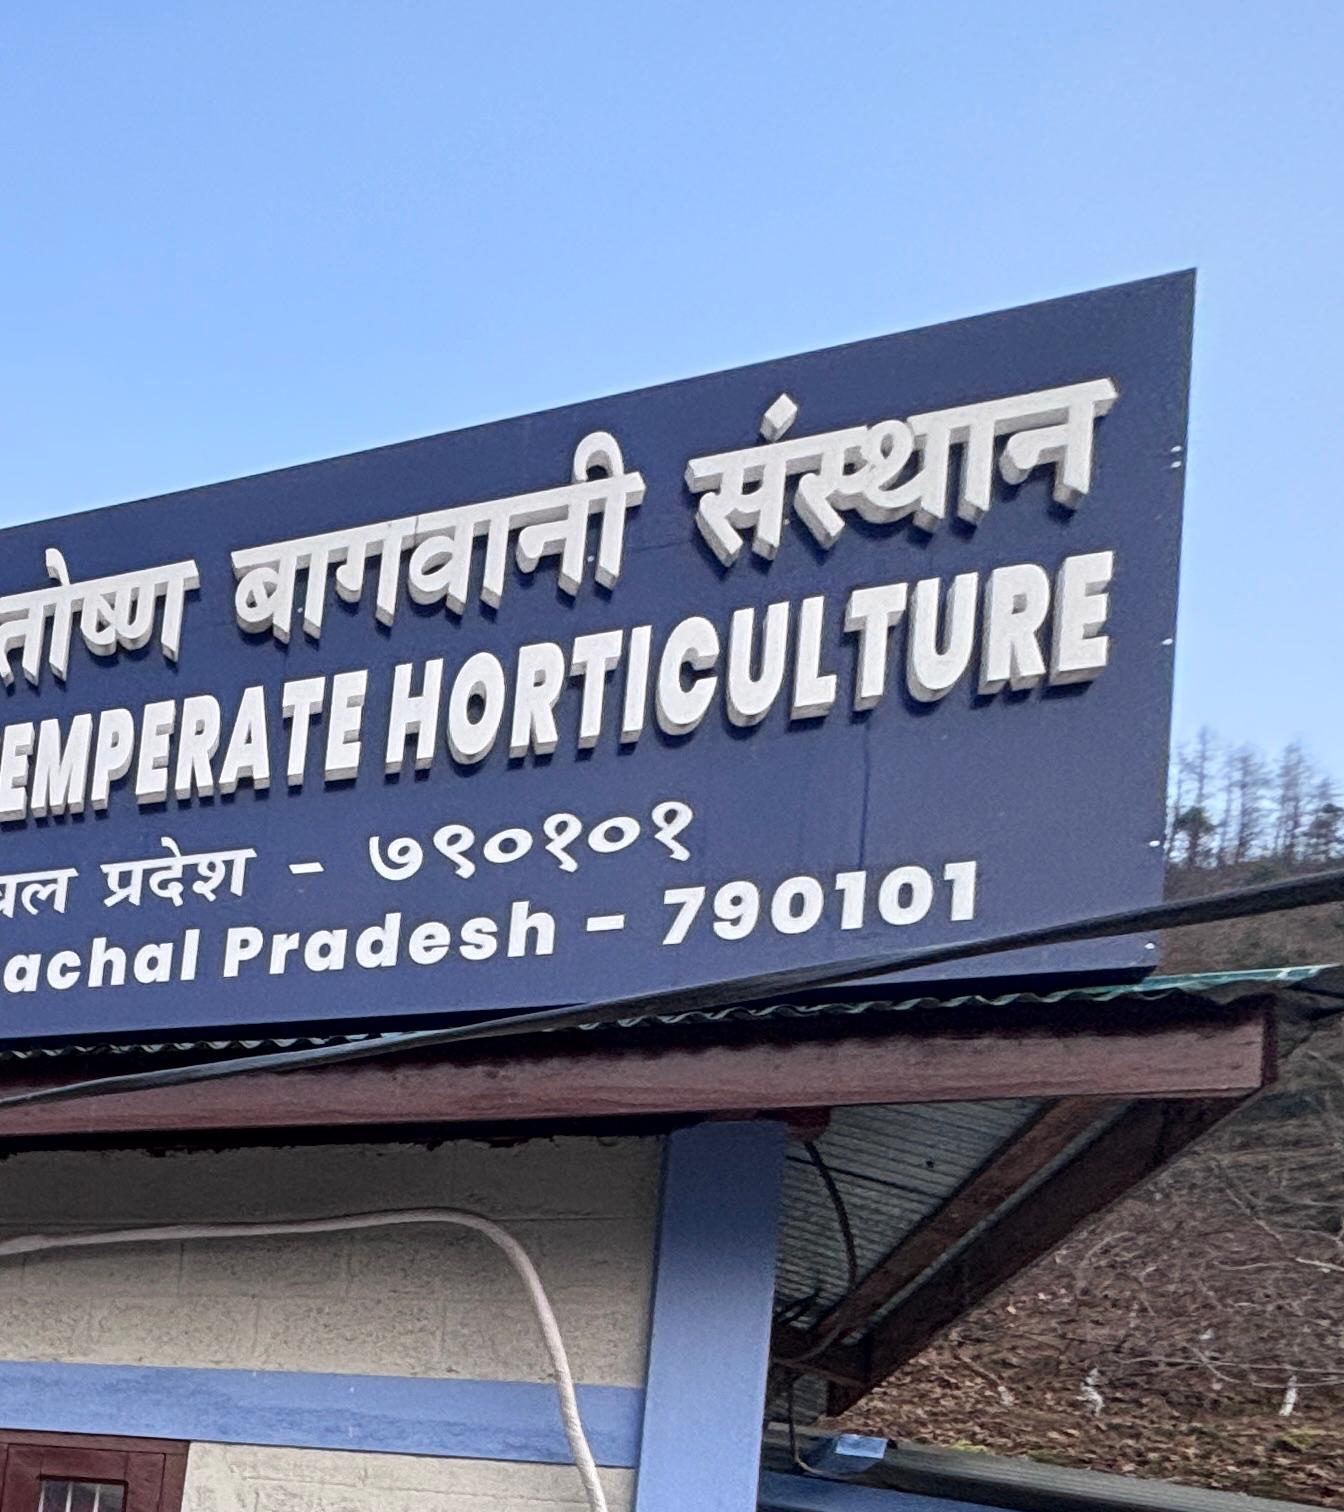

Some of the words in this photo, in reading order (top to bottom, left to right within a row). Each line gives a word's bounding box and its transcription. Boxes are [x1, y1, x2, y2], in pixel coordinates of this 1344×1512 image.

[230, 431, 647, 640] बागवानी
[684, 376, 1119, 566] संस्थान
[385, 550, 1115, 775] HORTICULTURE
[99, 836, 257, 908] प्रदेश
[368, 800, 694, 881] ७९०१०१
[223, 900, 556, 978] Pradesh
[662, 860, 978, 945] 790101
